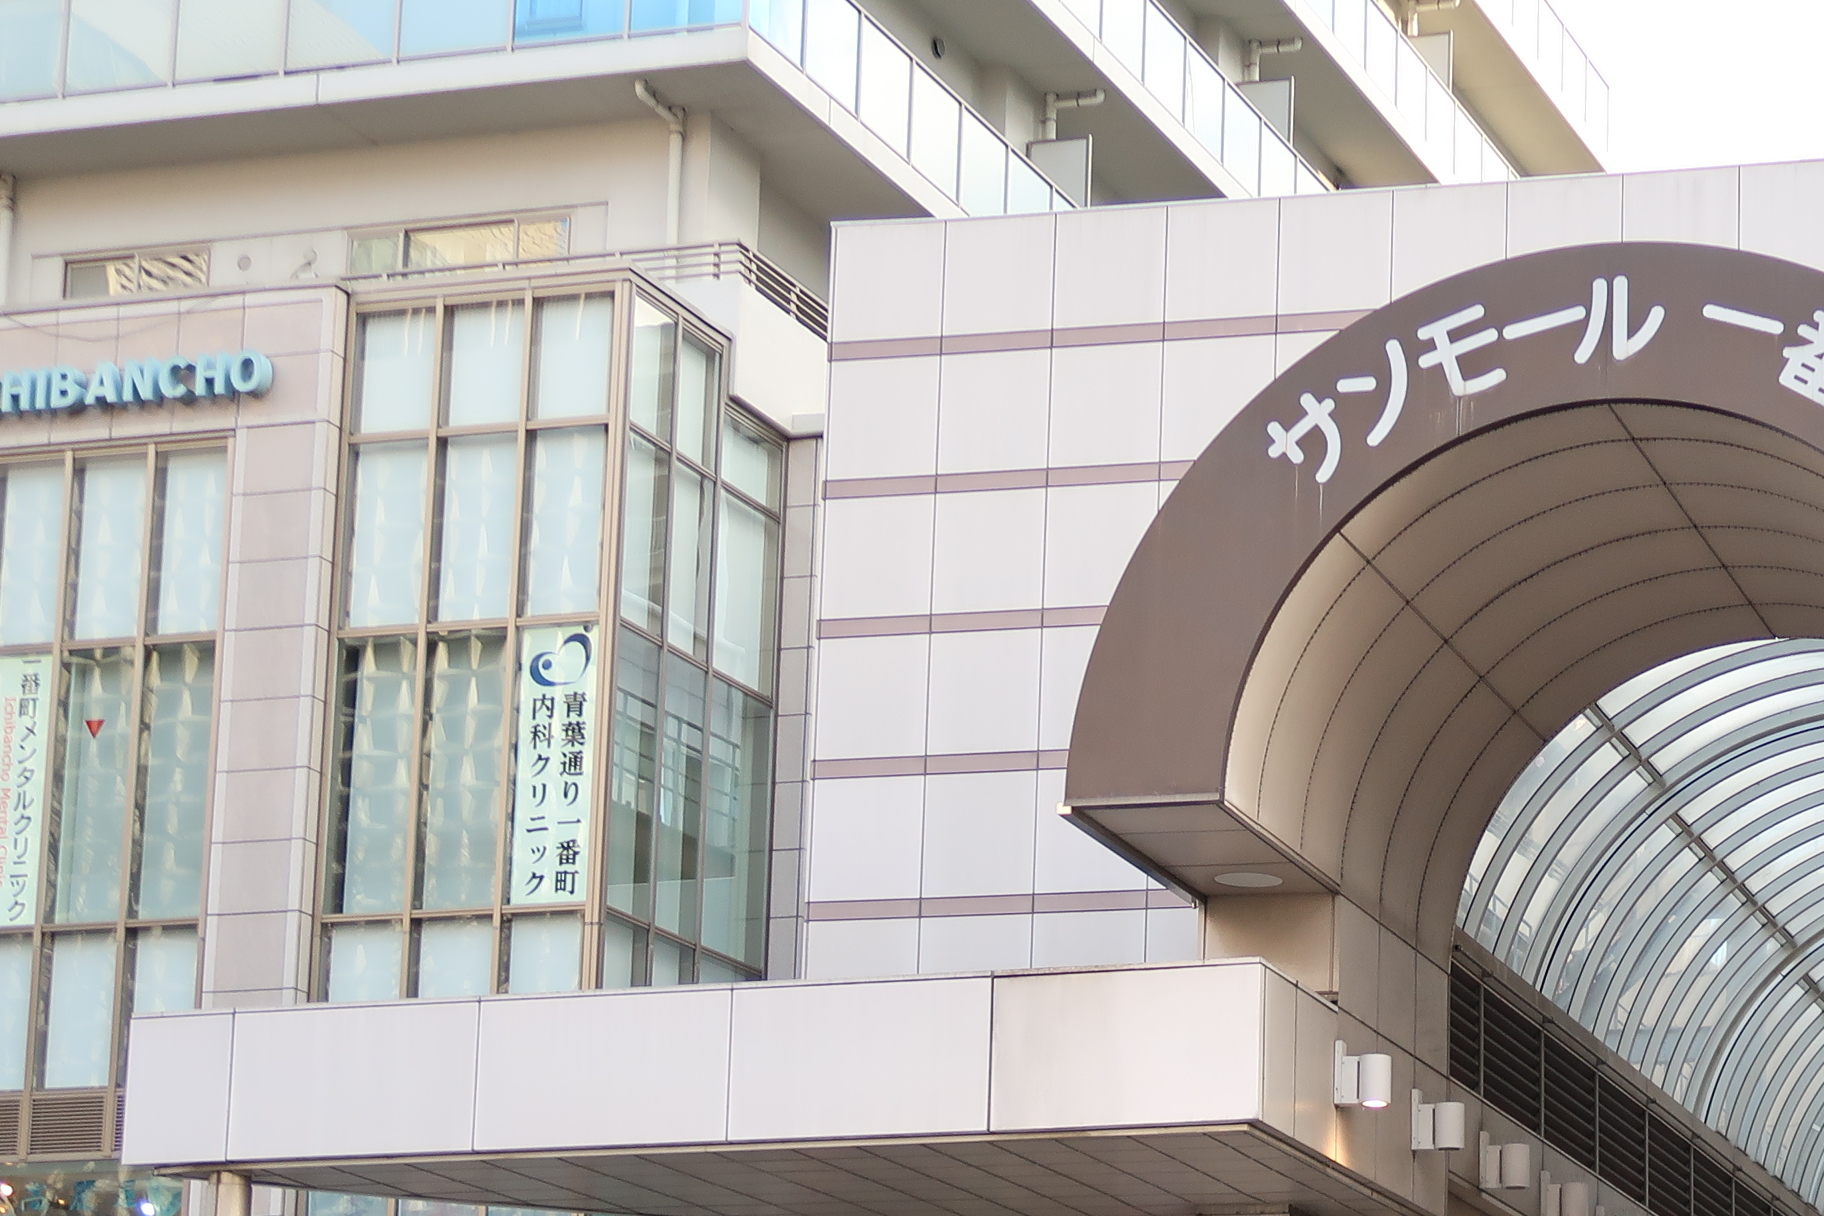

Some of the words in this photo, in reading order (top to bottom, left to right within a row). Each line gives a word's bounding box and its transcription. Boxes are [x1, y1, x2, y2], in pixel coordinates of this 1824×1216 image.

[1267, 274, 1665, 484] サンモール
[8, 659, 42, 922] 一番町メンタルクリニック
[524, 693, 555, 897] 内科クリニック
[554, 691, 587, 896] 青葉通り一番町
